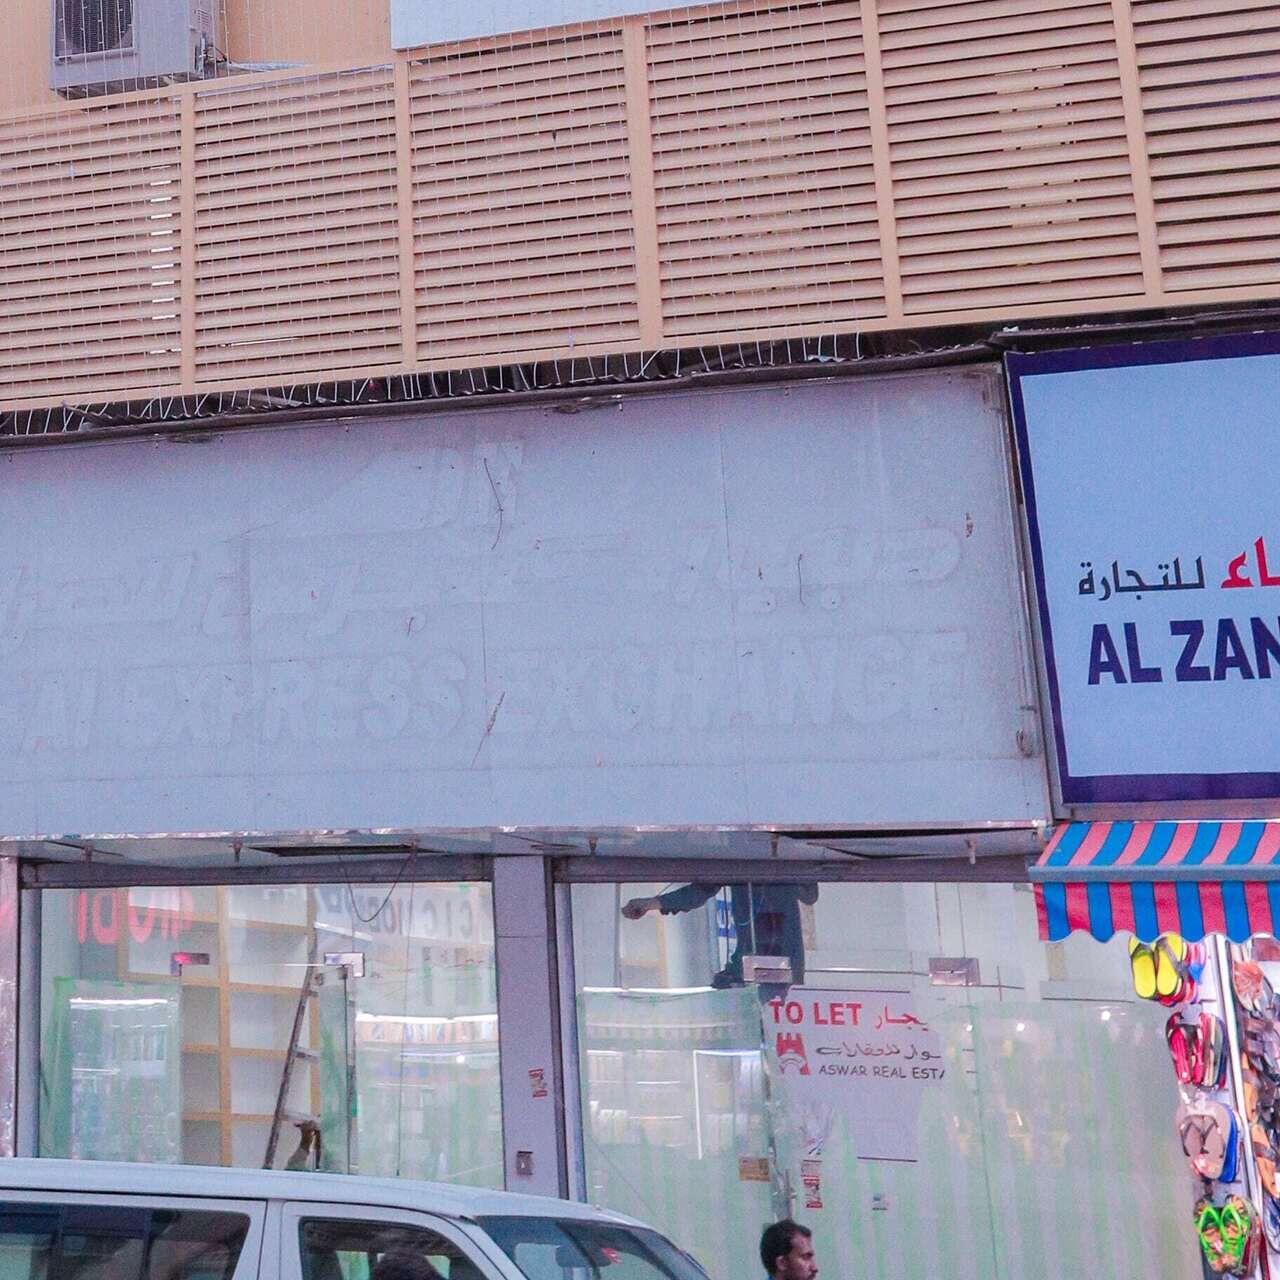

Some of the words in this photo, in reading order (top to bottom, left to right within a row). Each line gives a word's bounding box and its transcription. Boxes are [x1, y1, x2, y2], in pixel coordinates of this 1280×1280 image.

[1078, 555, 1206, 602] للتجارة
[1088, 622, 1163, 685] AL
[768, 999, 805, 1025] TO
[813, 1001, 863, 1026] LET
[818, 1064, 869, 1077] ASWAR
[873, 1065, 908, 1080] REAL
[911, 1066, 945, 1081] EST
